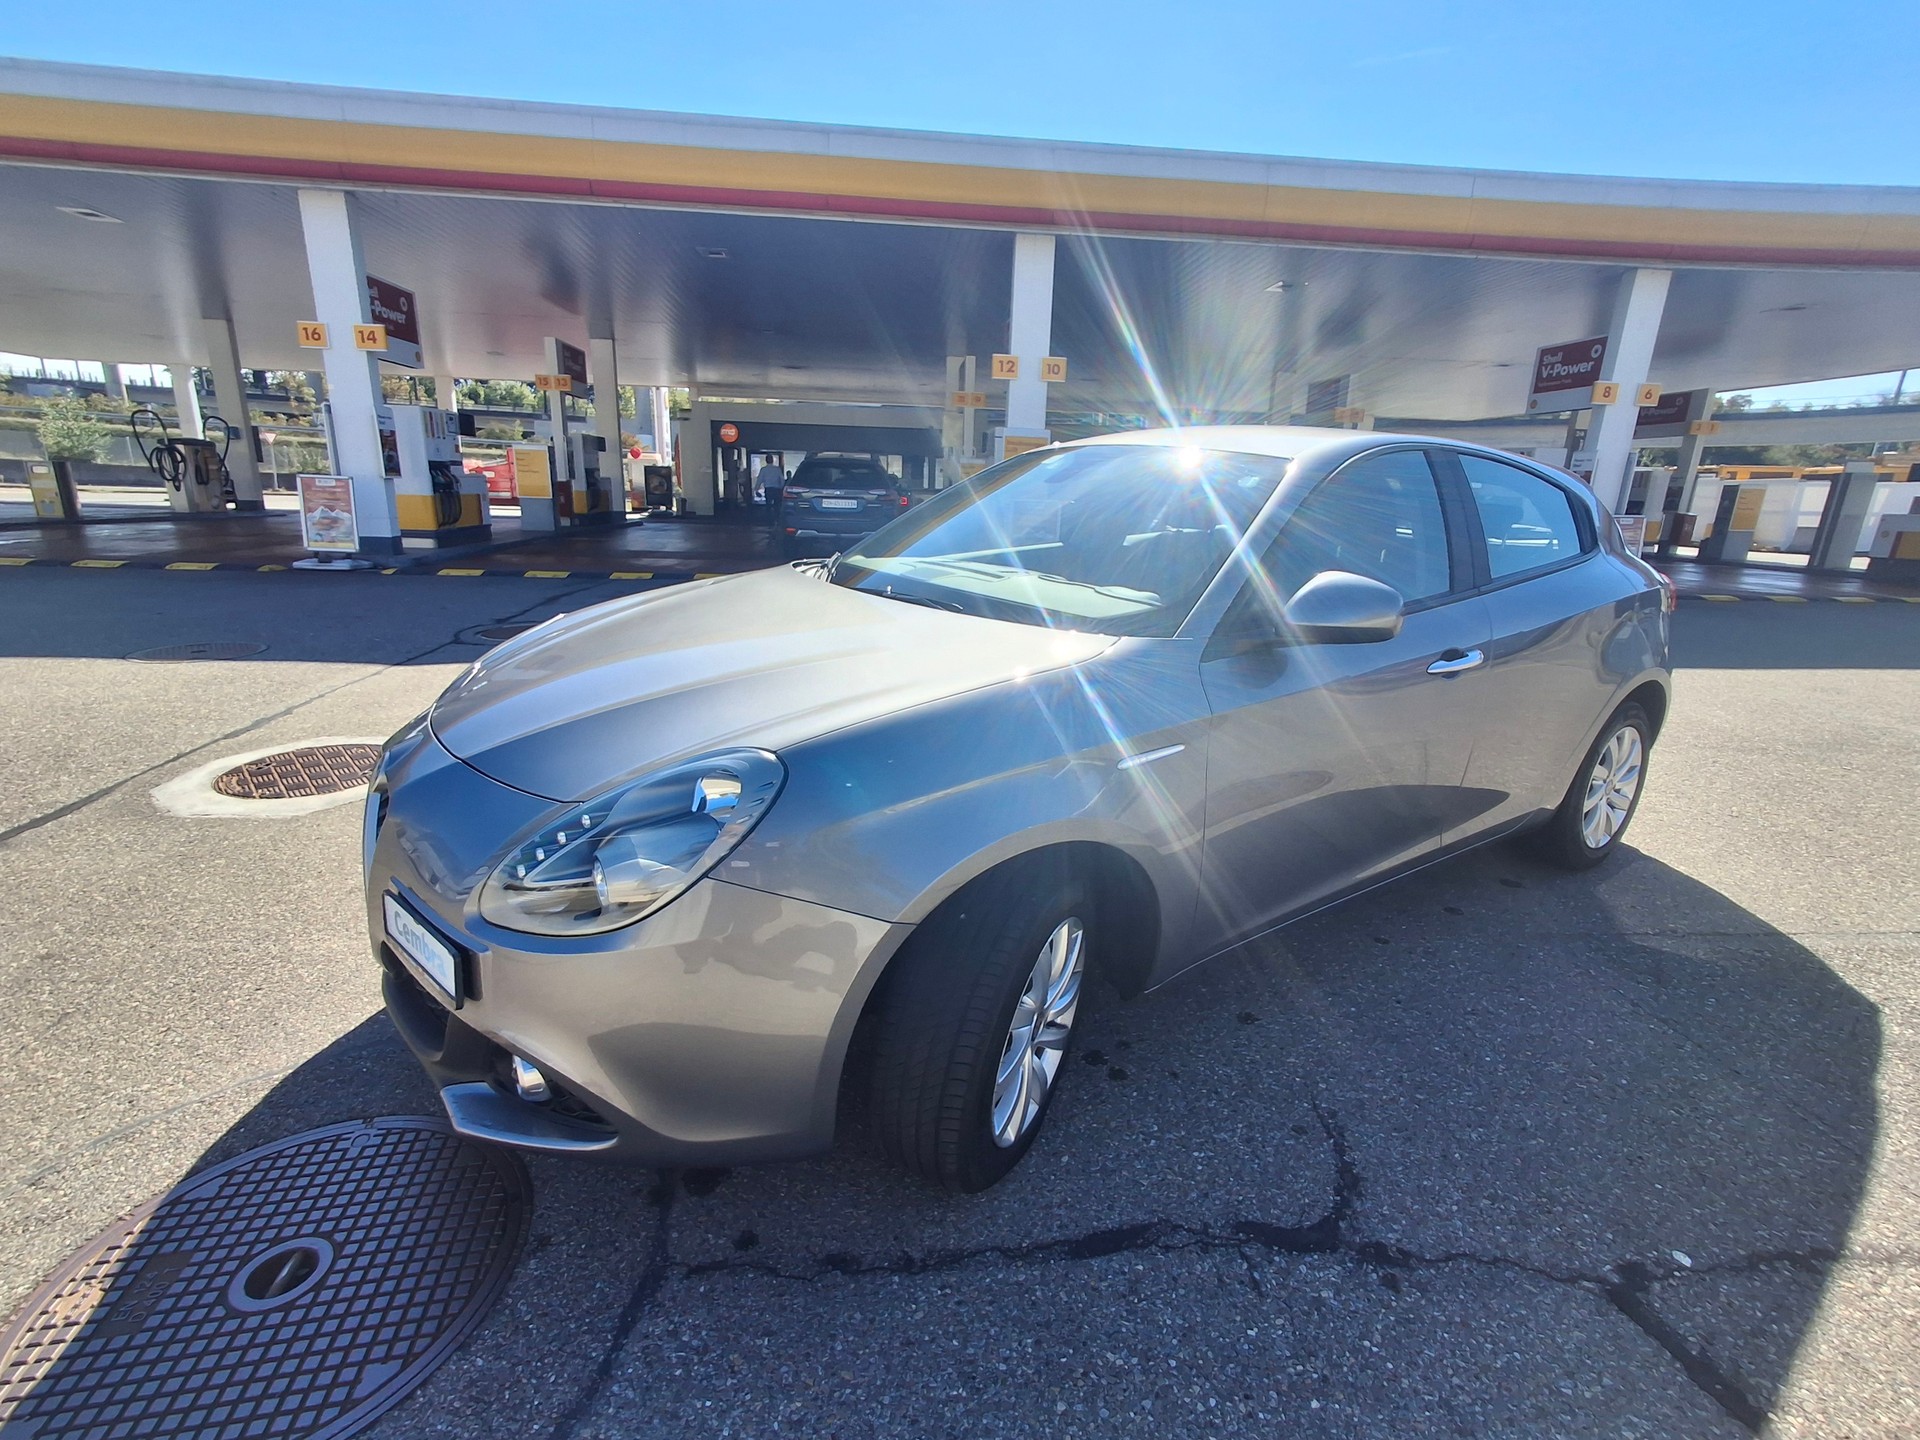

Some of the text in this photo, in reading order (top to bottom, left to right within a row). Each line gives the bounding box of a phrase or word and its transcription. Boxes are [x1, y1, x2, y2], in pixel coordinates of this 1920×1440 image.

[372, 300, 406, 324] -Power
[302, 327, 321, 341] 16
[358, 330, 378, 344] 14
[1543, 352, 1563, 364] Shell
[998, 360, 1016, 373] 12
[1047, 363, 1061, 375] 10
[1541, 361, 1595, 378] V-Power
[537, 377, 549, 386] 15
[556, 378, 568, 387] 13
[1603, 386, 1612, 398] 8
[1644, 389, 1653, 400] 6
[394, 910, 448, 977] Cembra
